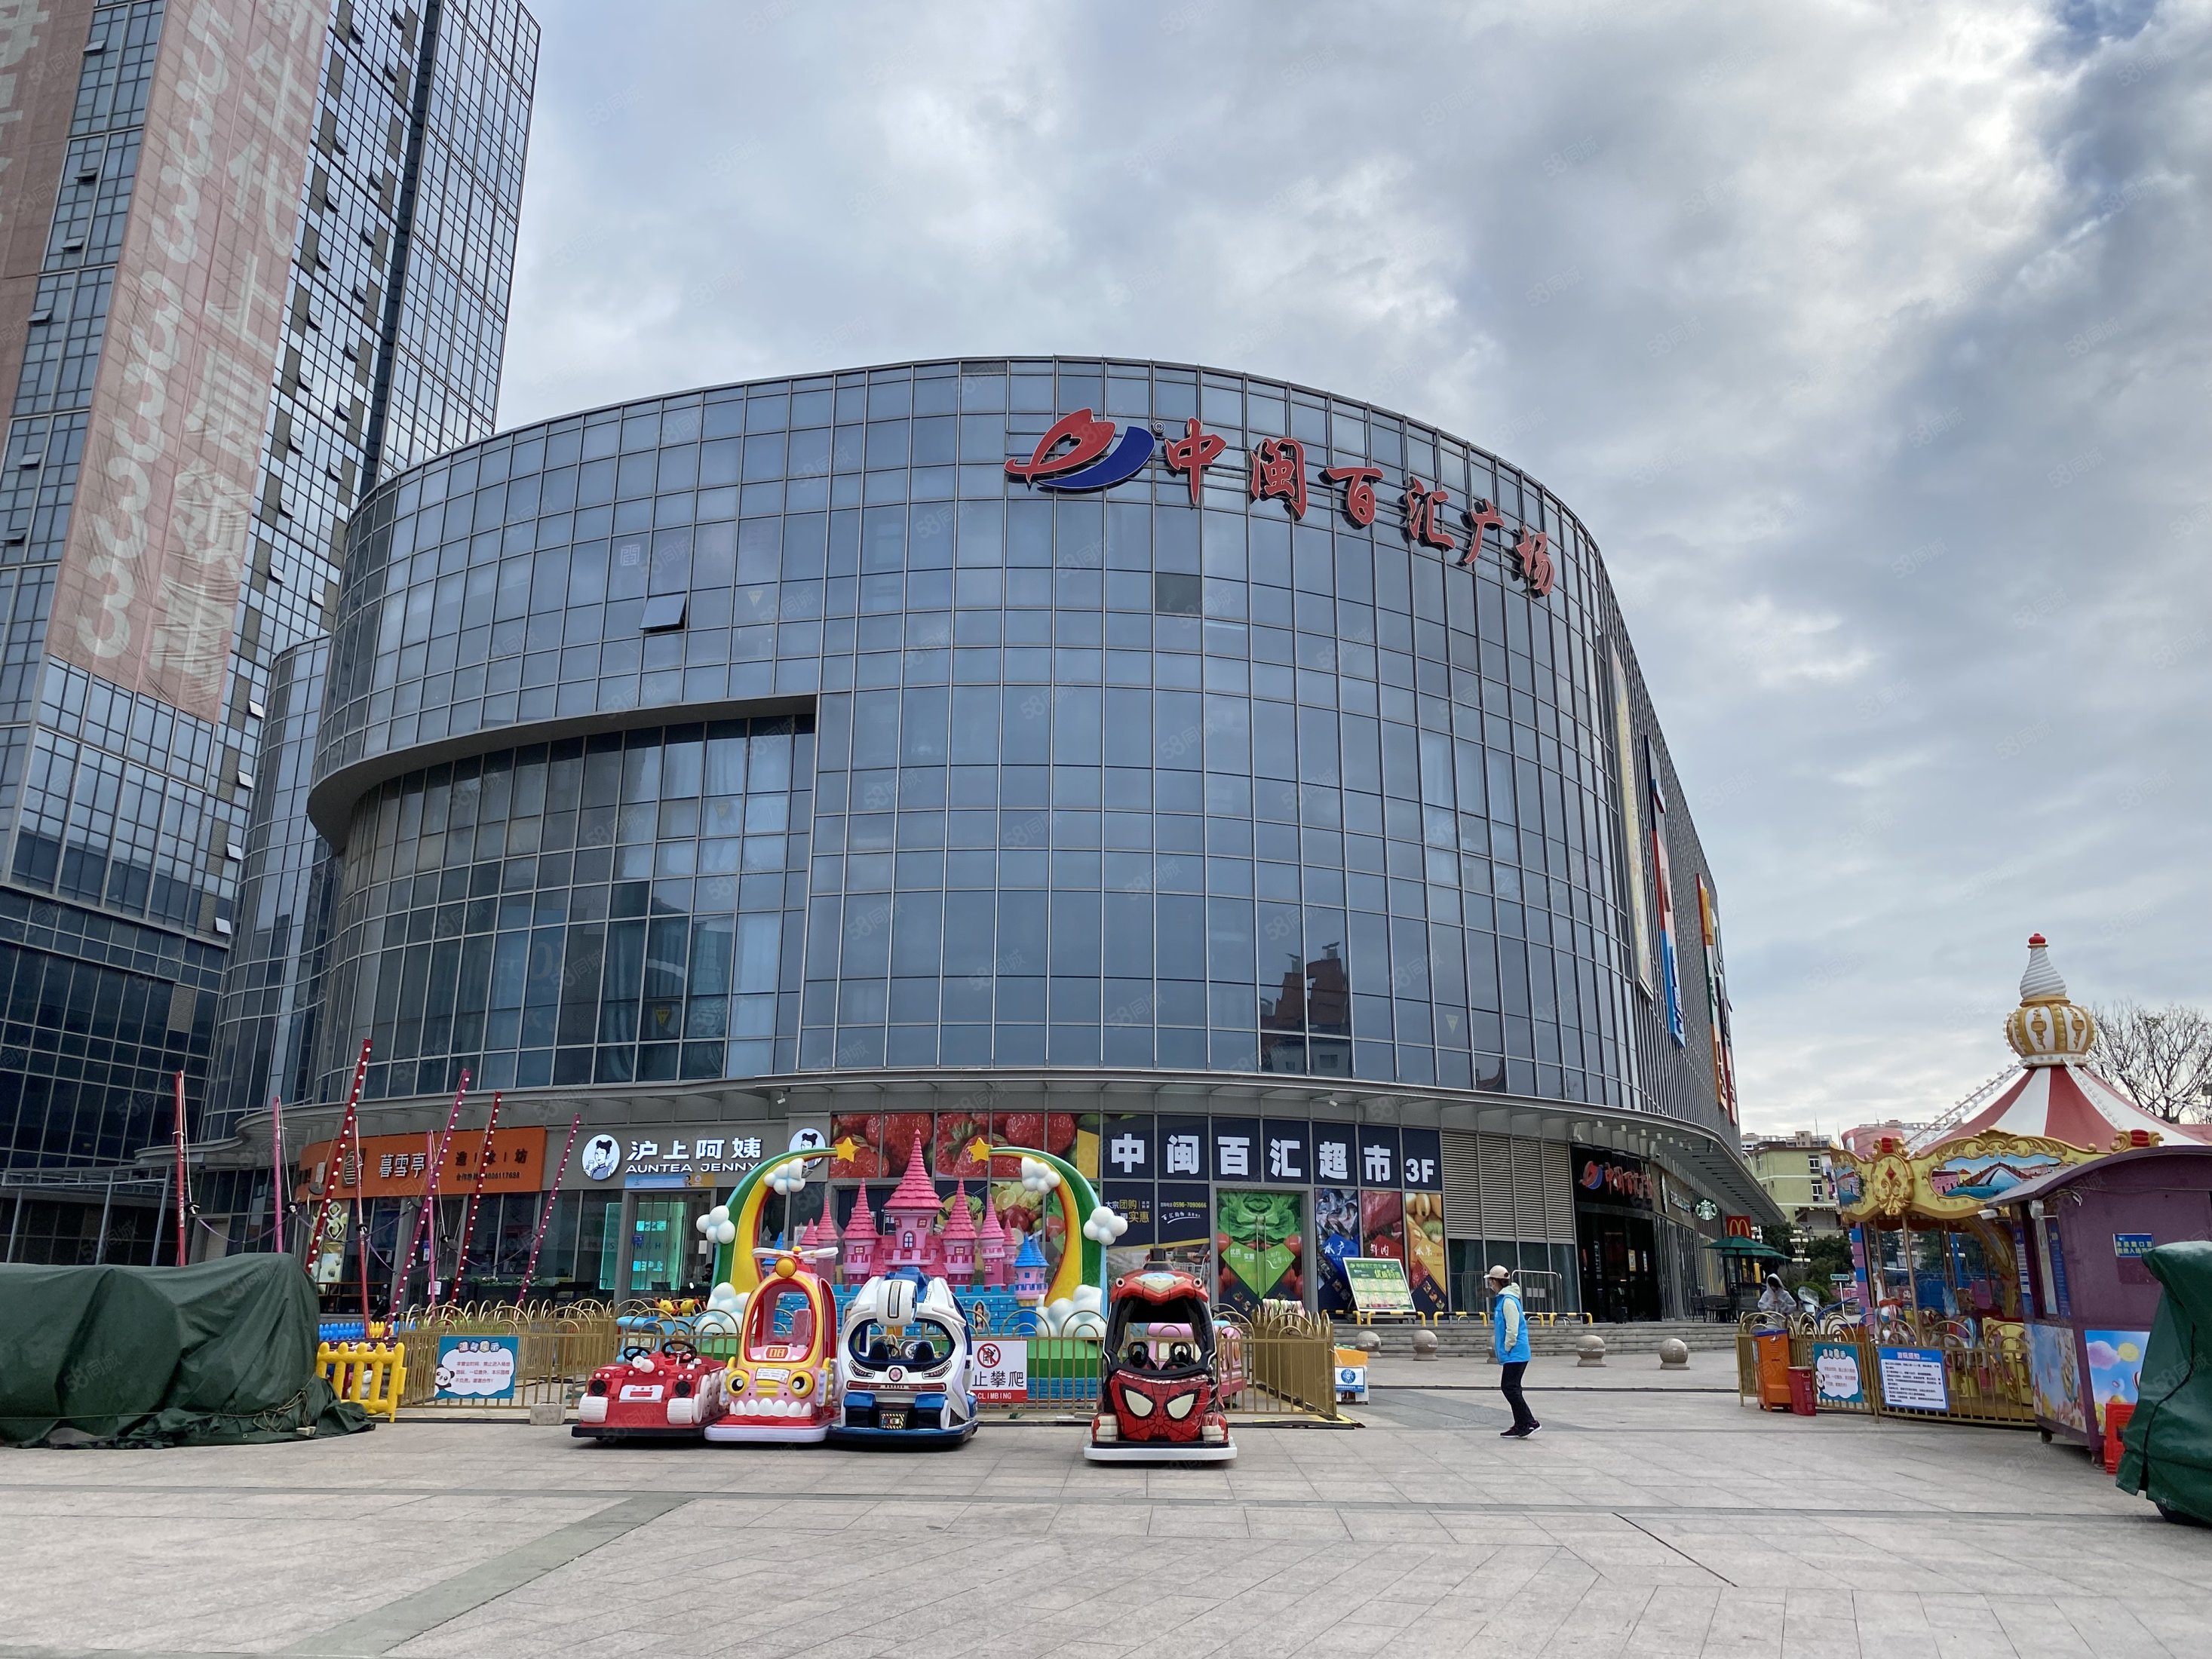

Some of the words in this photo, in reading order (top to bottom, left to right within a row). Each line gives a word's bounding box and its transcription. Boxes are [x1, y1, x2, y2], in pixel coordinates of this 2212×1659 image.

[1164, 417, 1557, 599] 中闽百汇广场
[626, 1136, 762, 1161] 沪上阿姨
[1110, 1133, 1391, 1182] 中闽百汇超市
[1405, 1158, 1435, 1183] 3F
[624, 1164, 693, 1173] AUNTEA
[700, 1162, 762, 1173] JENNY
